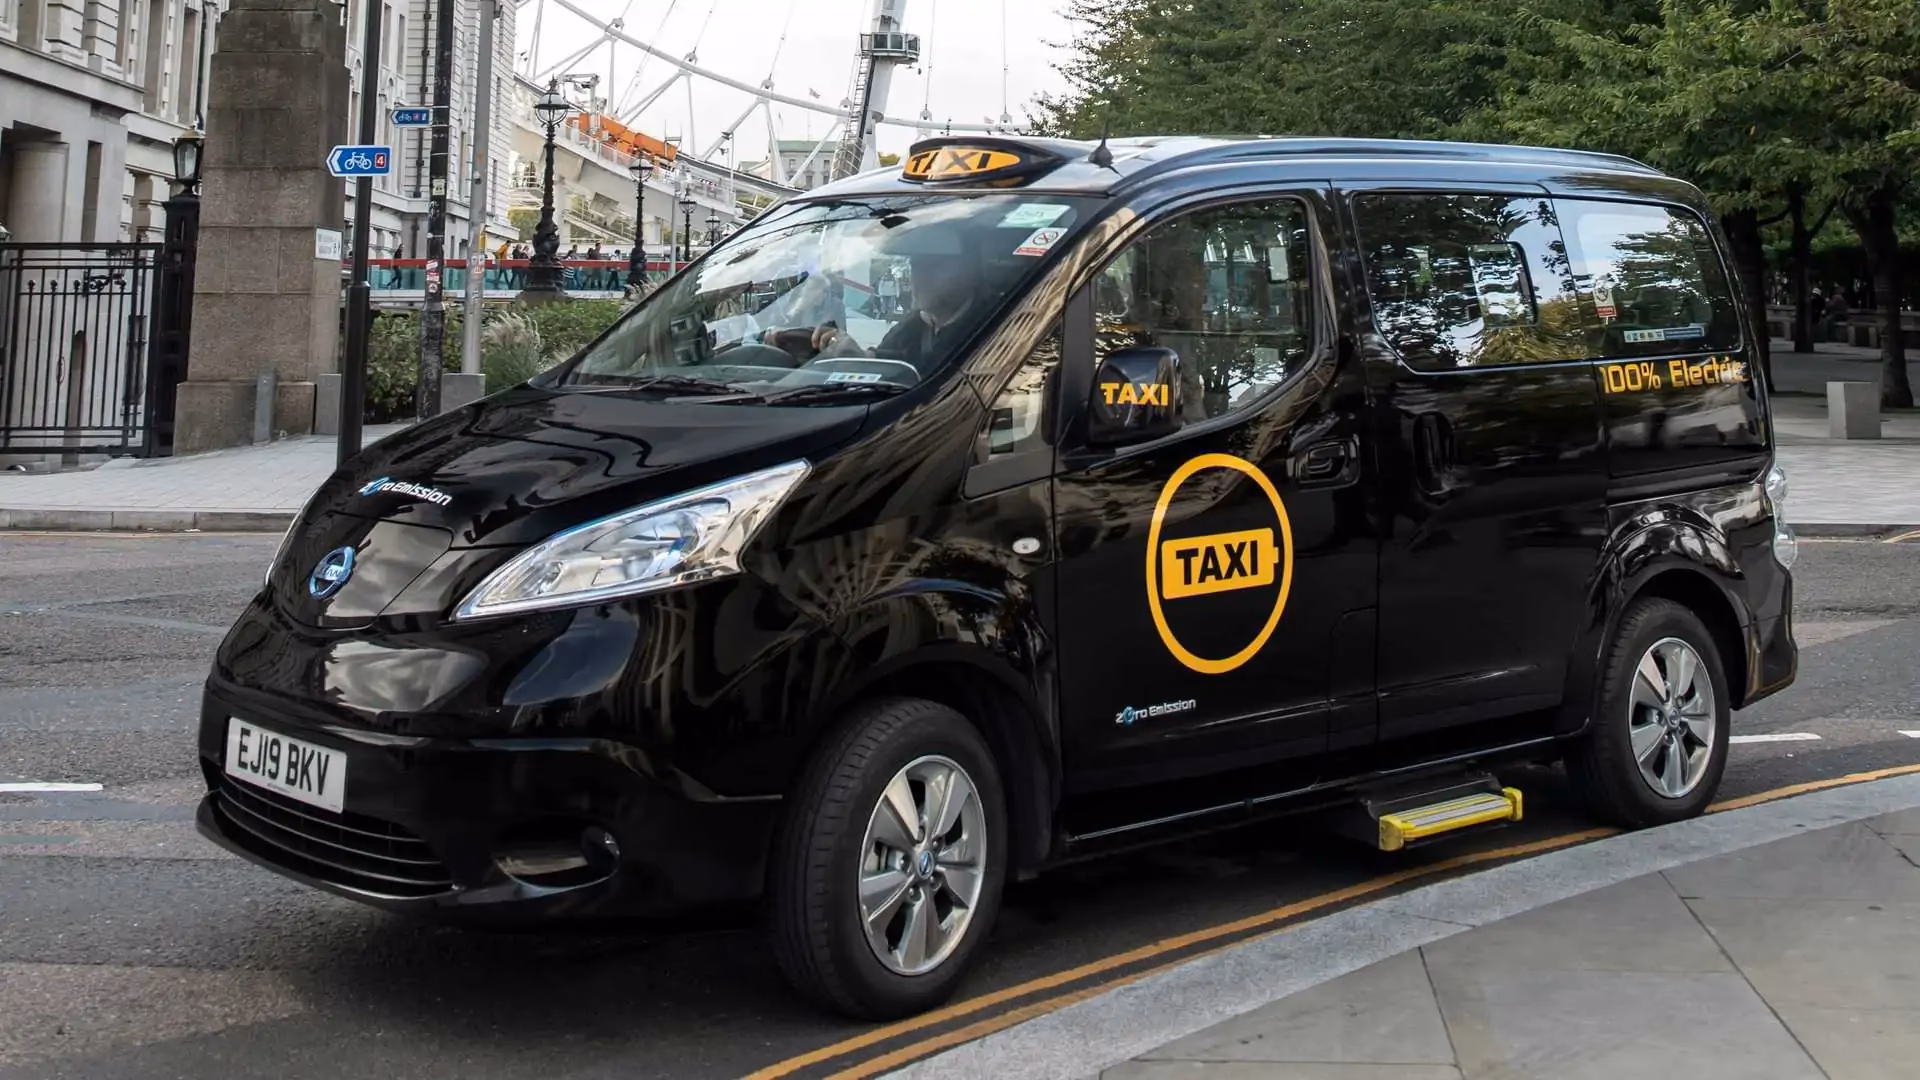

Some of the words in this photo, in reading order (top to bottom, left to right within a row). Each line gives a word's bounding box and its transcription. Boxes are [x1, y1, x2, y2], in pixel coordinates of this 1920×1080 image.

[376, 156, 384, 166] 4
[911, 151, 991, 173] TAXI
[1599, 362, 1661, 394] 100%
[1668, 356, 1749, 388] Electric
[1100, 383, 1168, 405] TAXI
[391, 482, 452, 506] Emission
[1175, 540, 1259, 585] TAXI
[1148, 699, 1196, 717] Emission
[238, 727, 281, 780] EJ19
[285, 742, 330, 796] BKV
